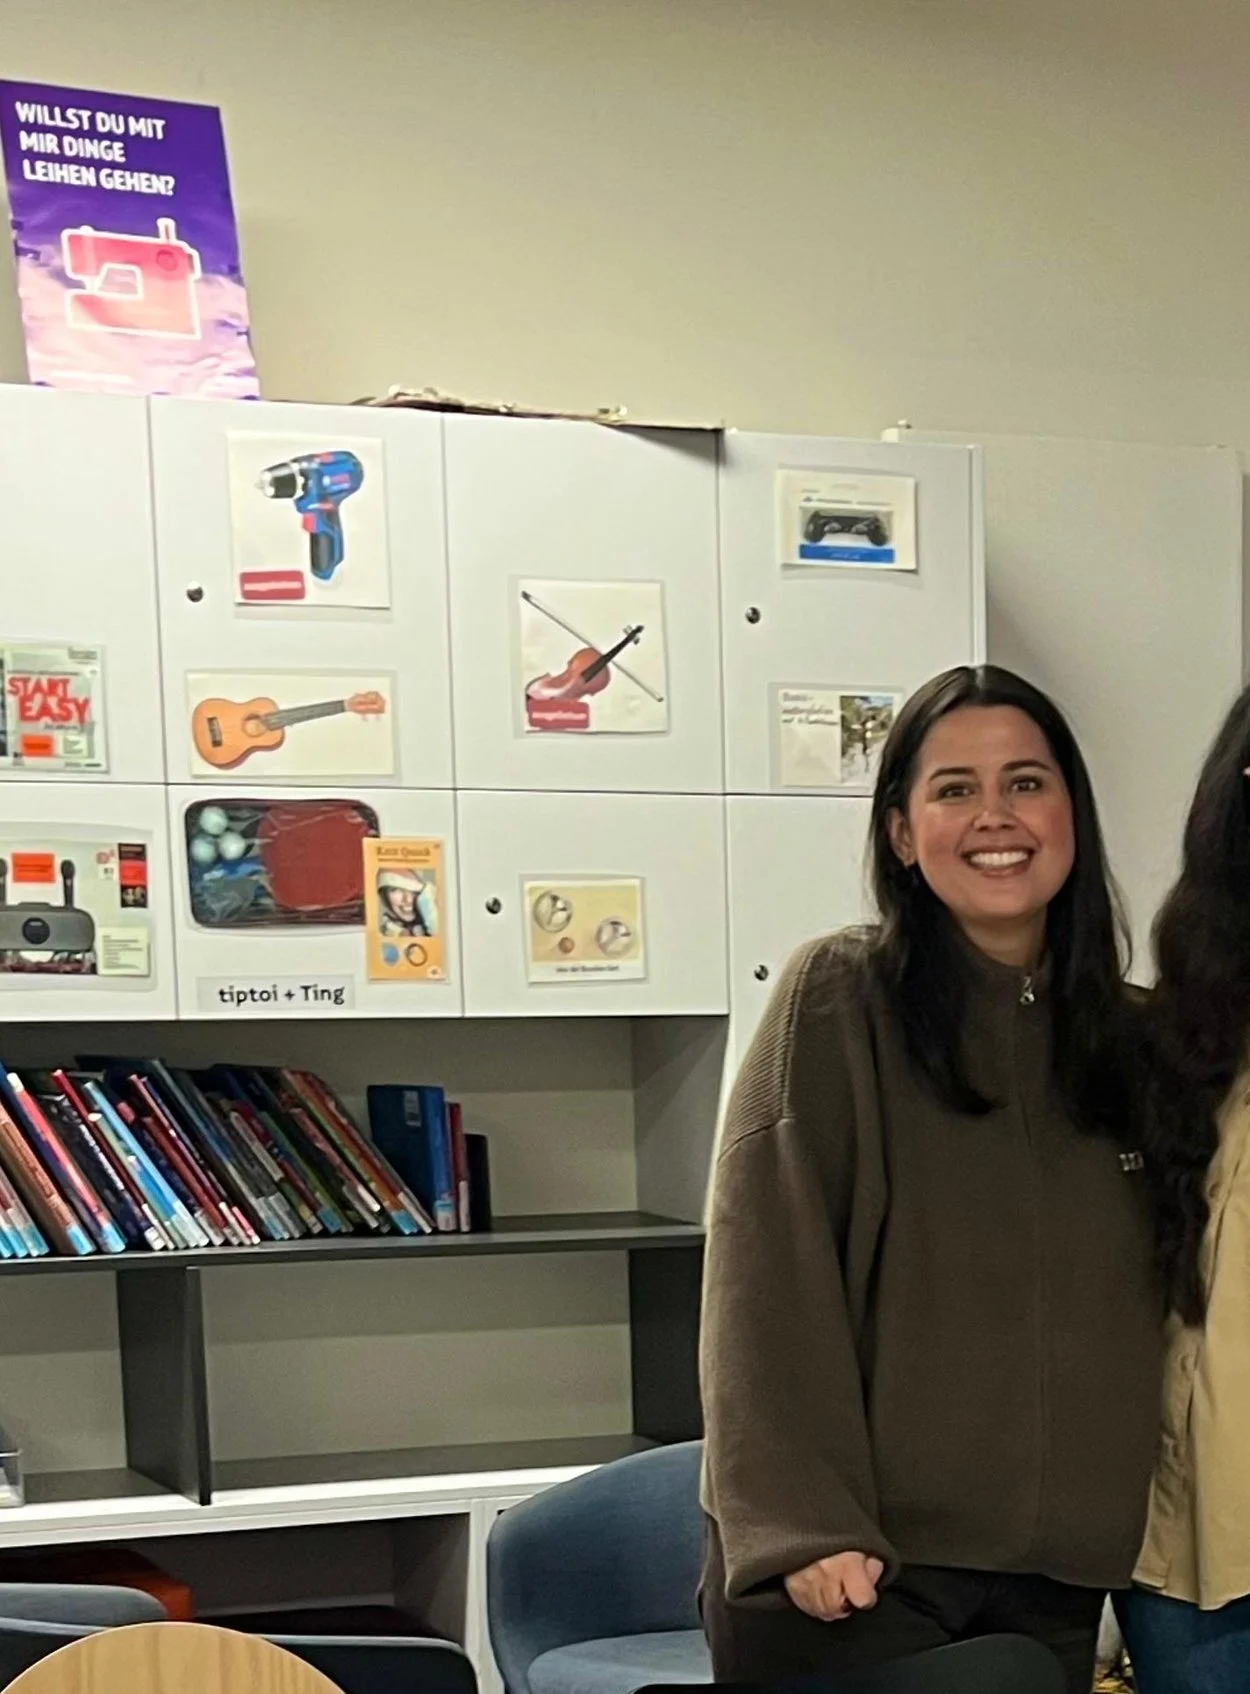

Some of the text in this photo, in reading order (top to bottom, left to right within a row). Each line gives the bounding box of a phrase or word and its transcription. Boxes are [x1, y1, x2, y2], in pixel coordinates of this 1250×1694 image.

[15, 101, 166, 140] WILLST DU MIT
[19, 130, 126, 163] MIR DINGE
[22, 159, 175, 196] LEIHEN GEHEN?
[8, 676, 70, 697] START
[19, 696, 91, 726] EASY
[218, 984, 345, 1007] tiptoi + Ting
